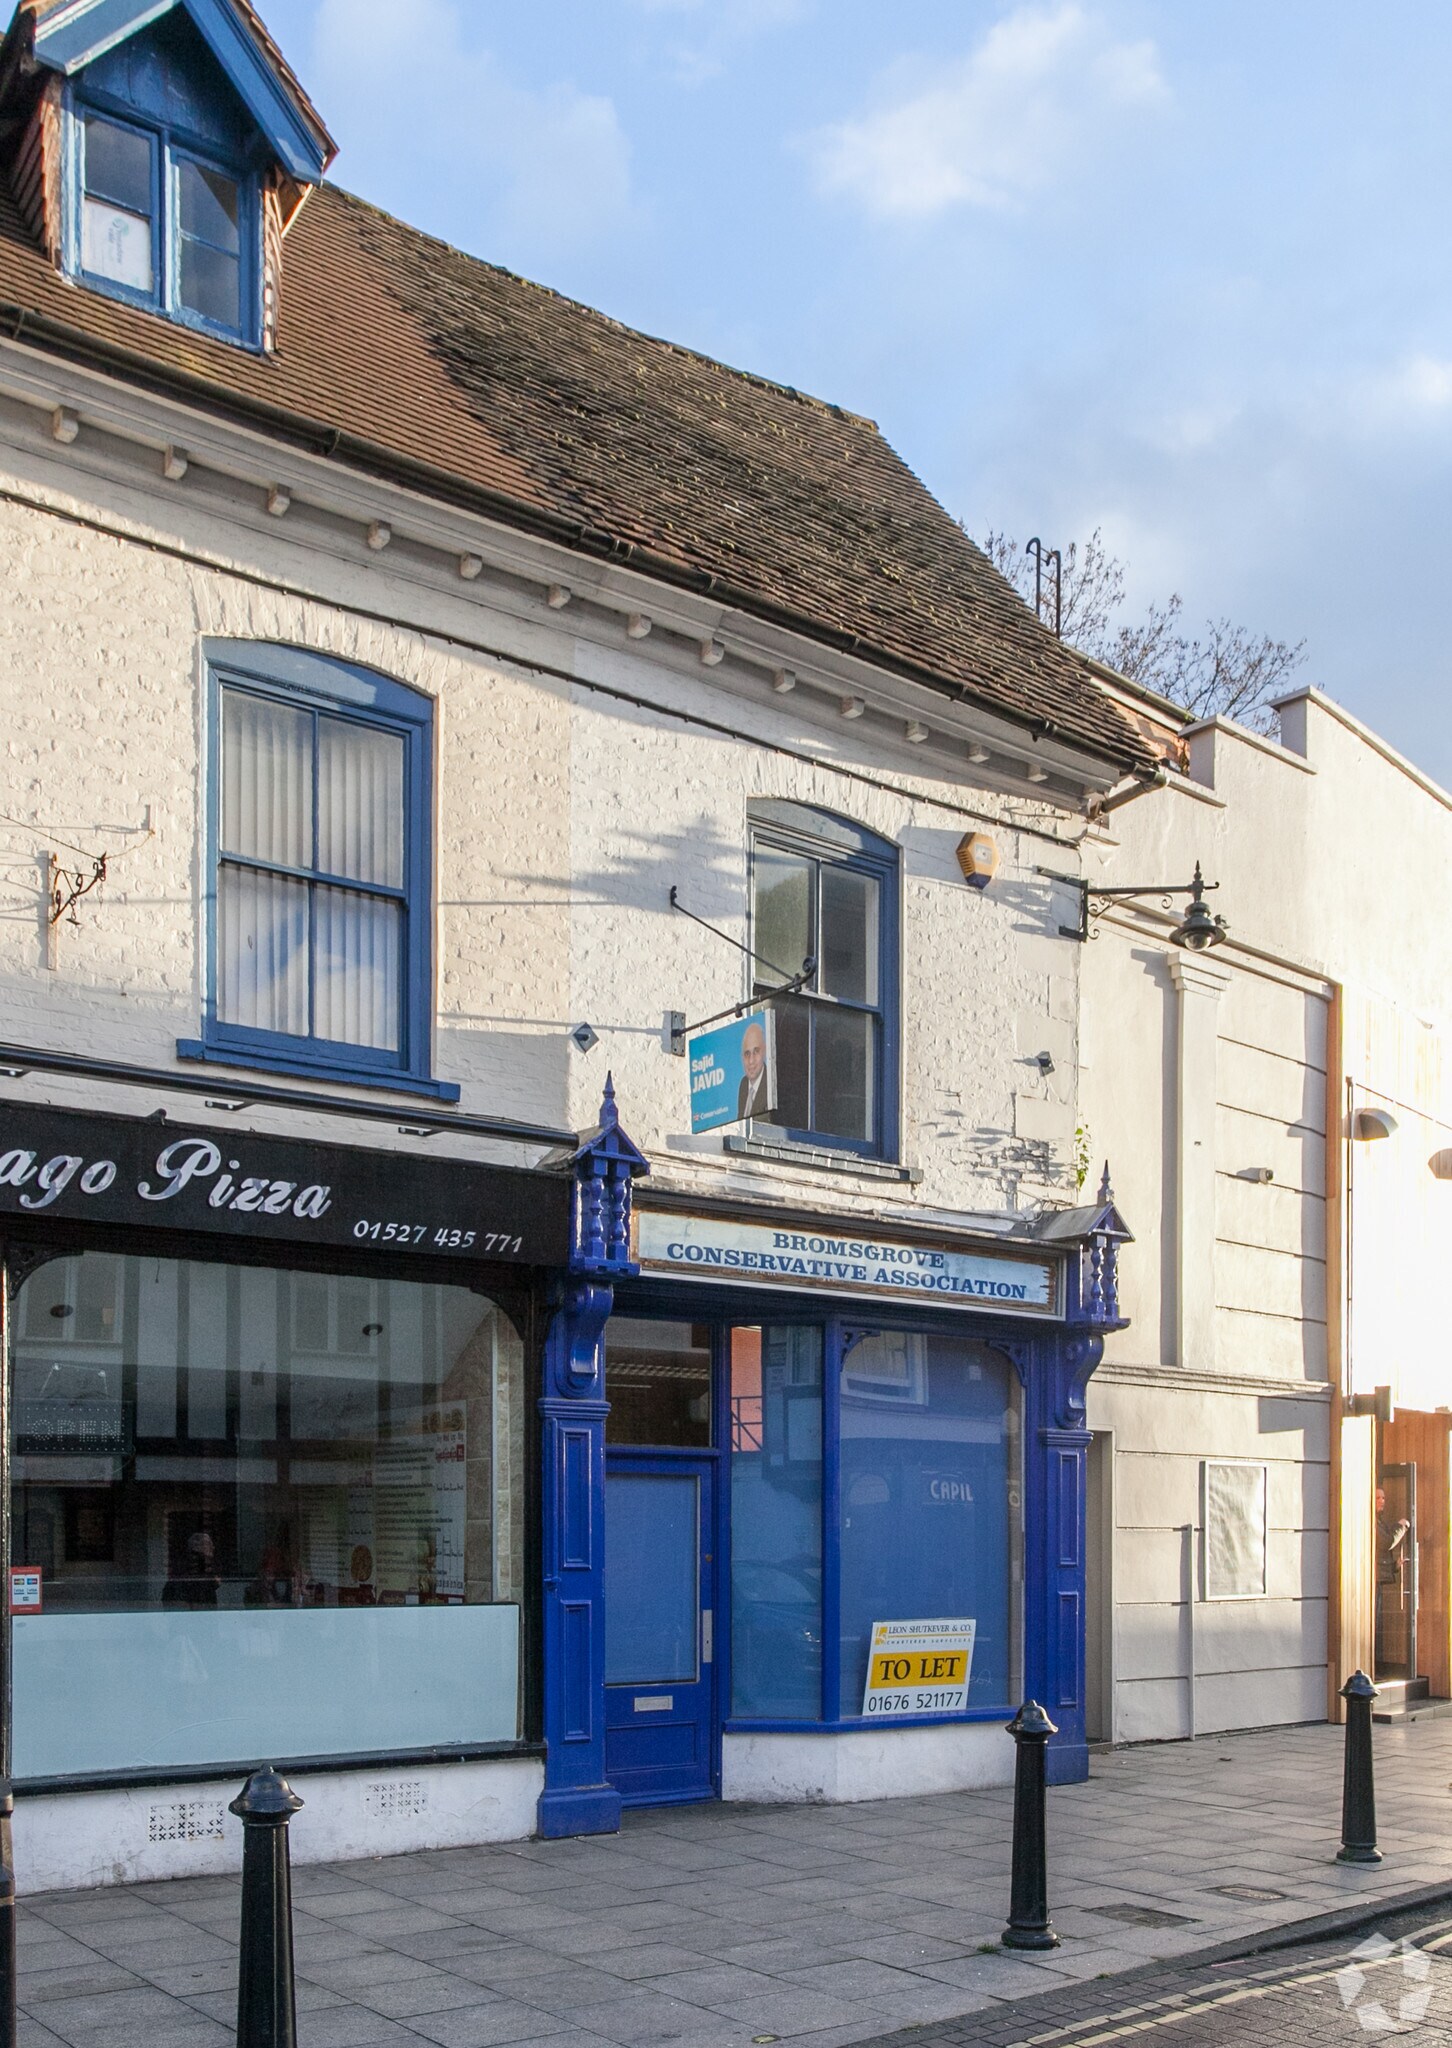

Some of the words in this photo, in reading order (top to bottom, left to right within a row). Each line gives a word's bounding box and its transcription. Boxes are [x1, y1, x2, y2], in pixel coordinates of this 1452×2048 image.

[692, 1054, 714, 1072] Sajid
[693, 1068, 725, 1093] JAVID
[138, 1138, 333, 1219] Pizza
[352, 1219, 428, 1244] 01527
[433, 1228, 475, 1248] 435
[484, 1232, 523, 1253] 771
[772, 1232, 945, 1270] BROMSGROVE
[666, 1242, 868, 1282] CONSERVATIVE
[873, 1267, 1027, 1300] ASSOCIATION
[31, 1418, 121, 1443] OPEN
[888, 1626, 907, 1634] LEON
[879, 1659, 911, 1681] TO
[919, 1656, 961, 1679] LET
[868, 1694, 910, 1712] 01676
[915, 1691, 963, 1709] 521177
